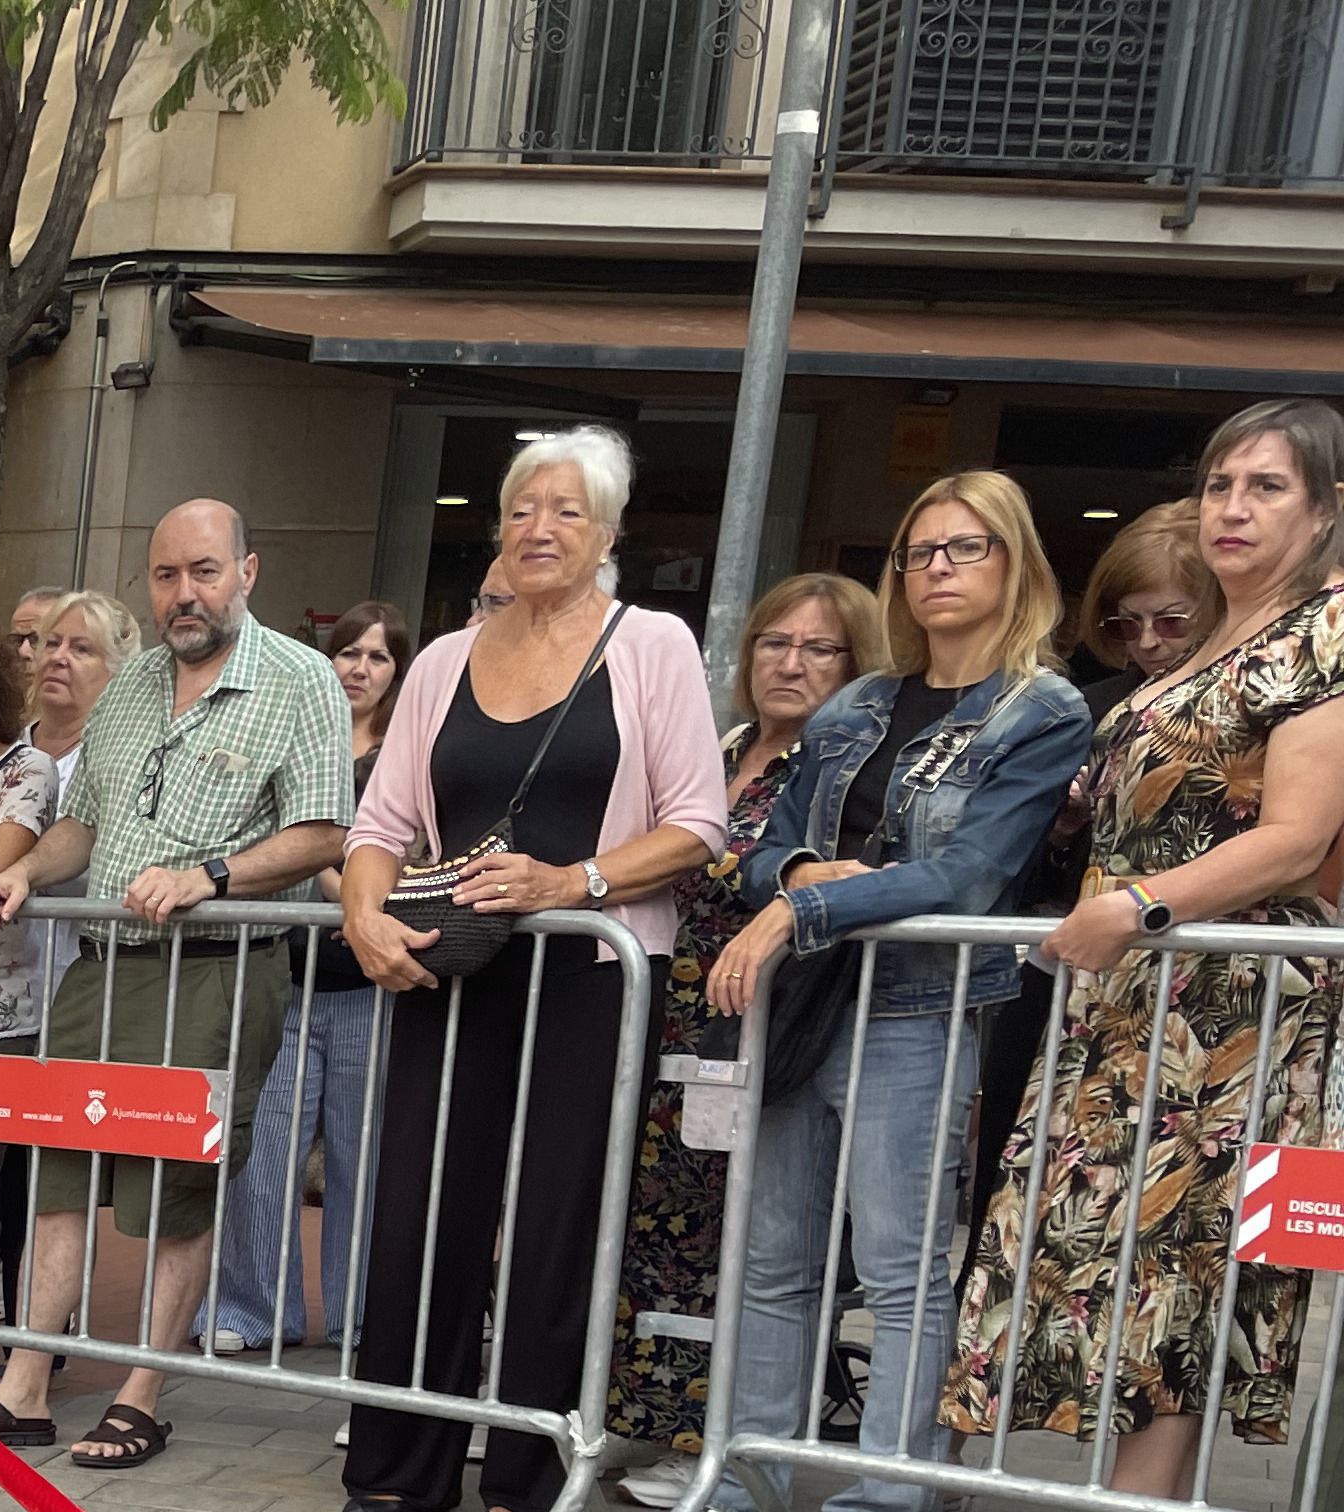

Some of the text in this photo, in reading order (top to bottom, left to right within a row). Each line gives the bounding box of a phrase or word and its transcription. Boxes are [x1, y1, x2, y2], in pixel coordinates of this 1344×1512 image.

[111, 1107, 161, 1121] Ajuntament
[162, 1110, 174, 1122] de
[1288, 1199, 1344, 1217] DISCUL
[1285, 1218, 1344, 1237] LES MO
